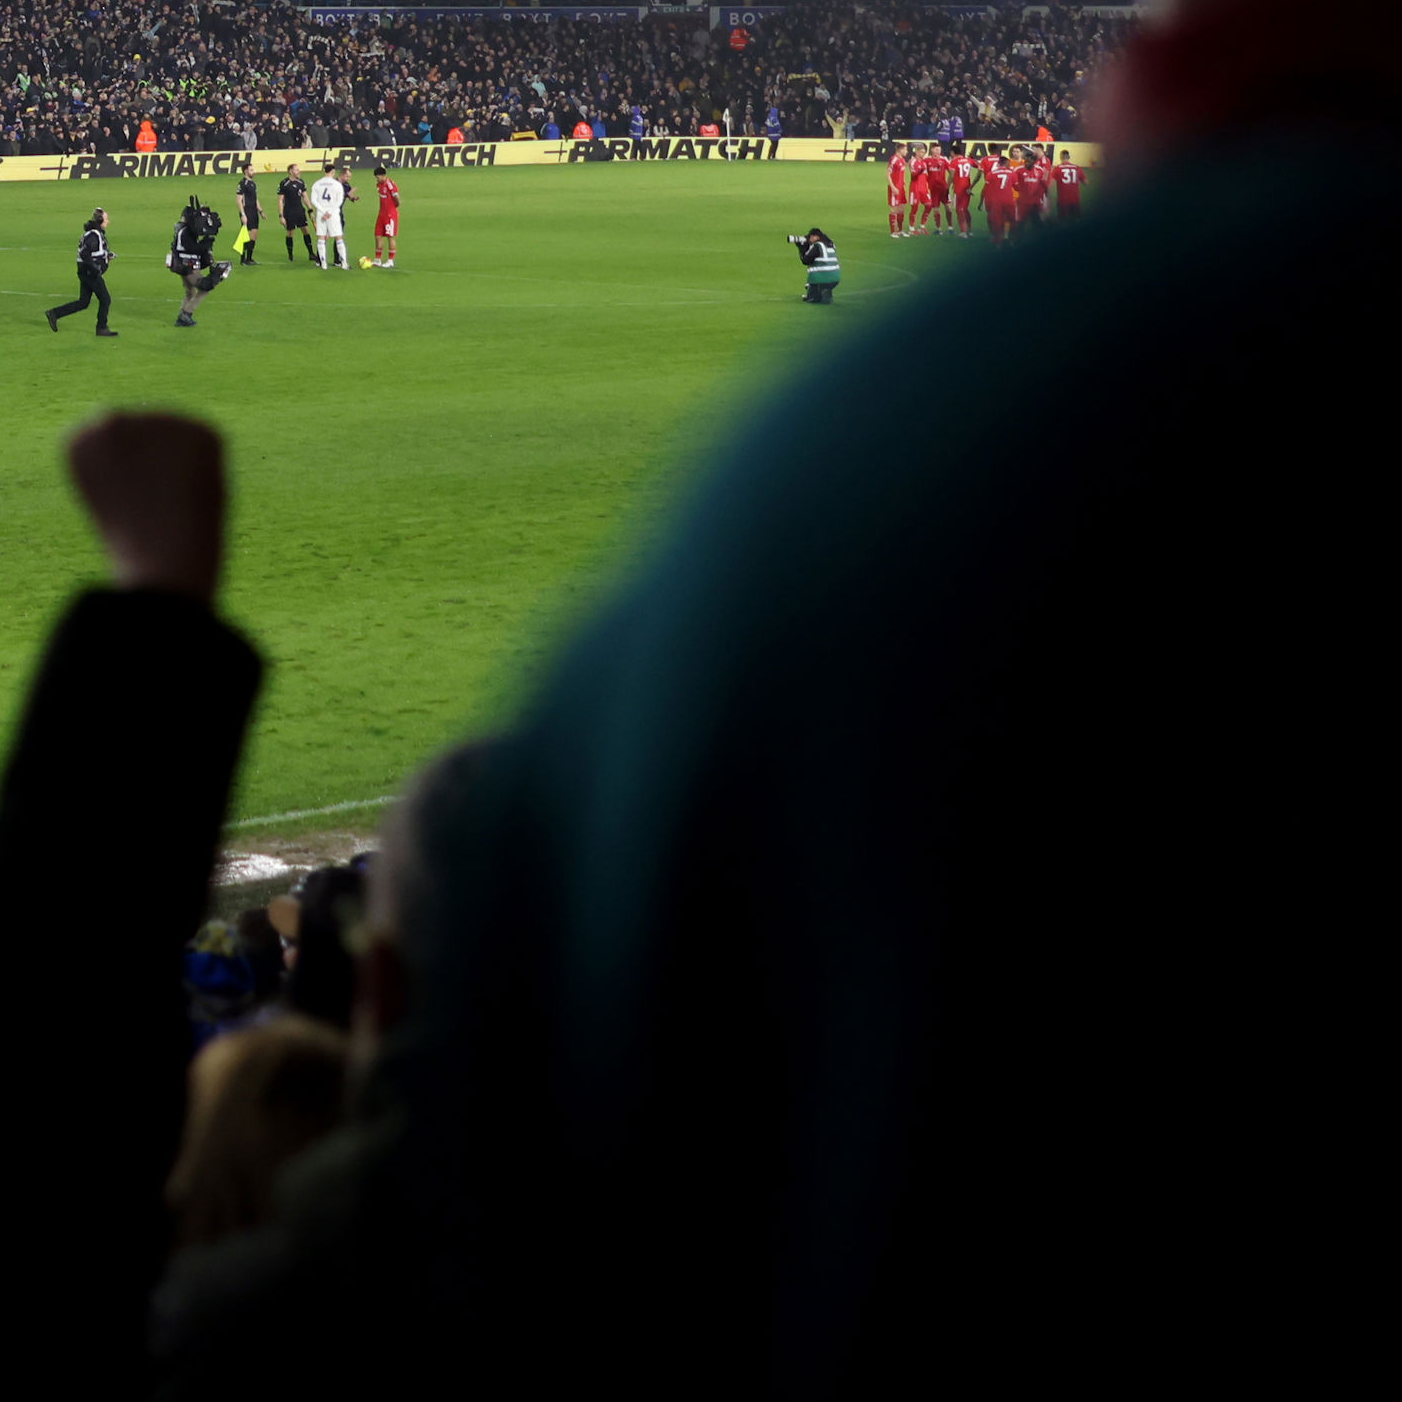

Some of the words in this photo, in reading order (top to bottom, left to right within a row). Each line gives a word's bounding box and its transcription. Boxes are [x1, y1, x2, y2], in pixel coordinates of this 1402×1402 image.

[334, 144, 497, 169] PRIMATCH
[69, 152, 253, 179] PRIMATCH
[957, 162, 971, 178] 19
[997, 173, 1008, 189] 7
[1061, 168, 1077, 184] 31
[322, 187, 331, 202] 4
